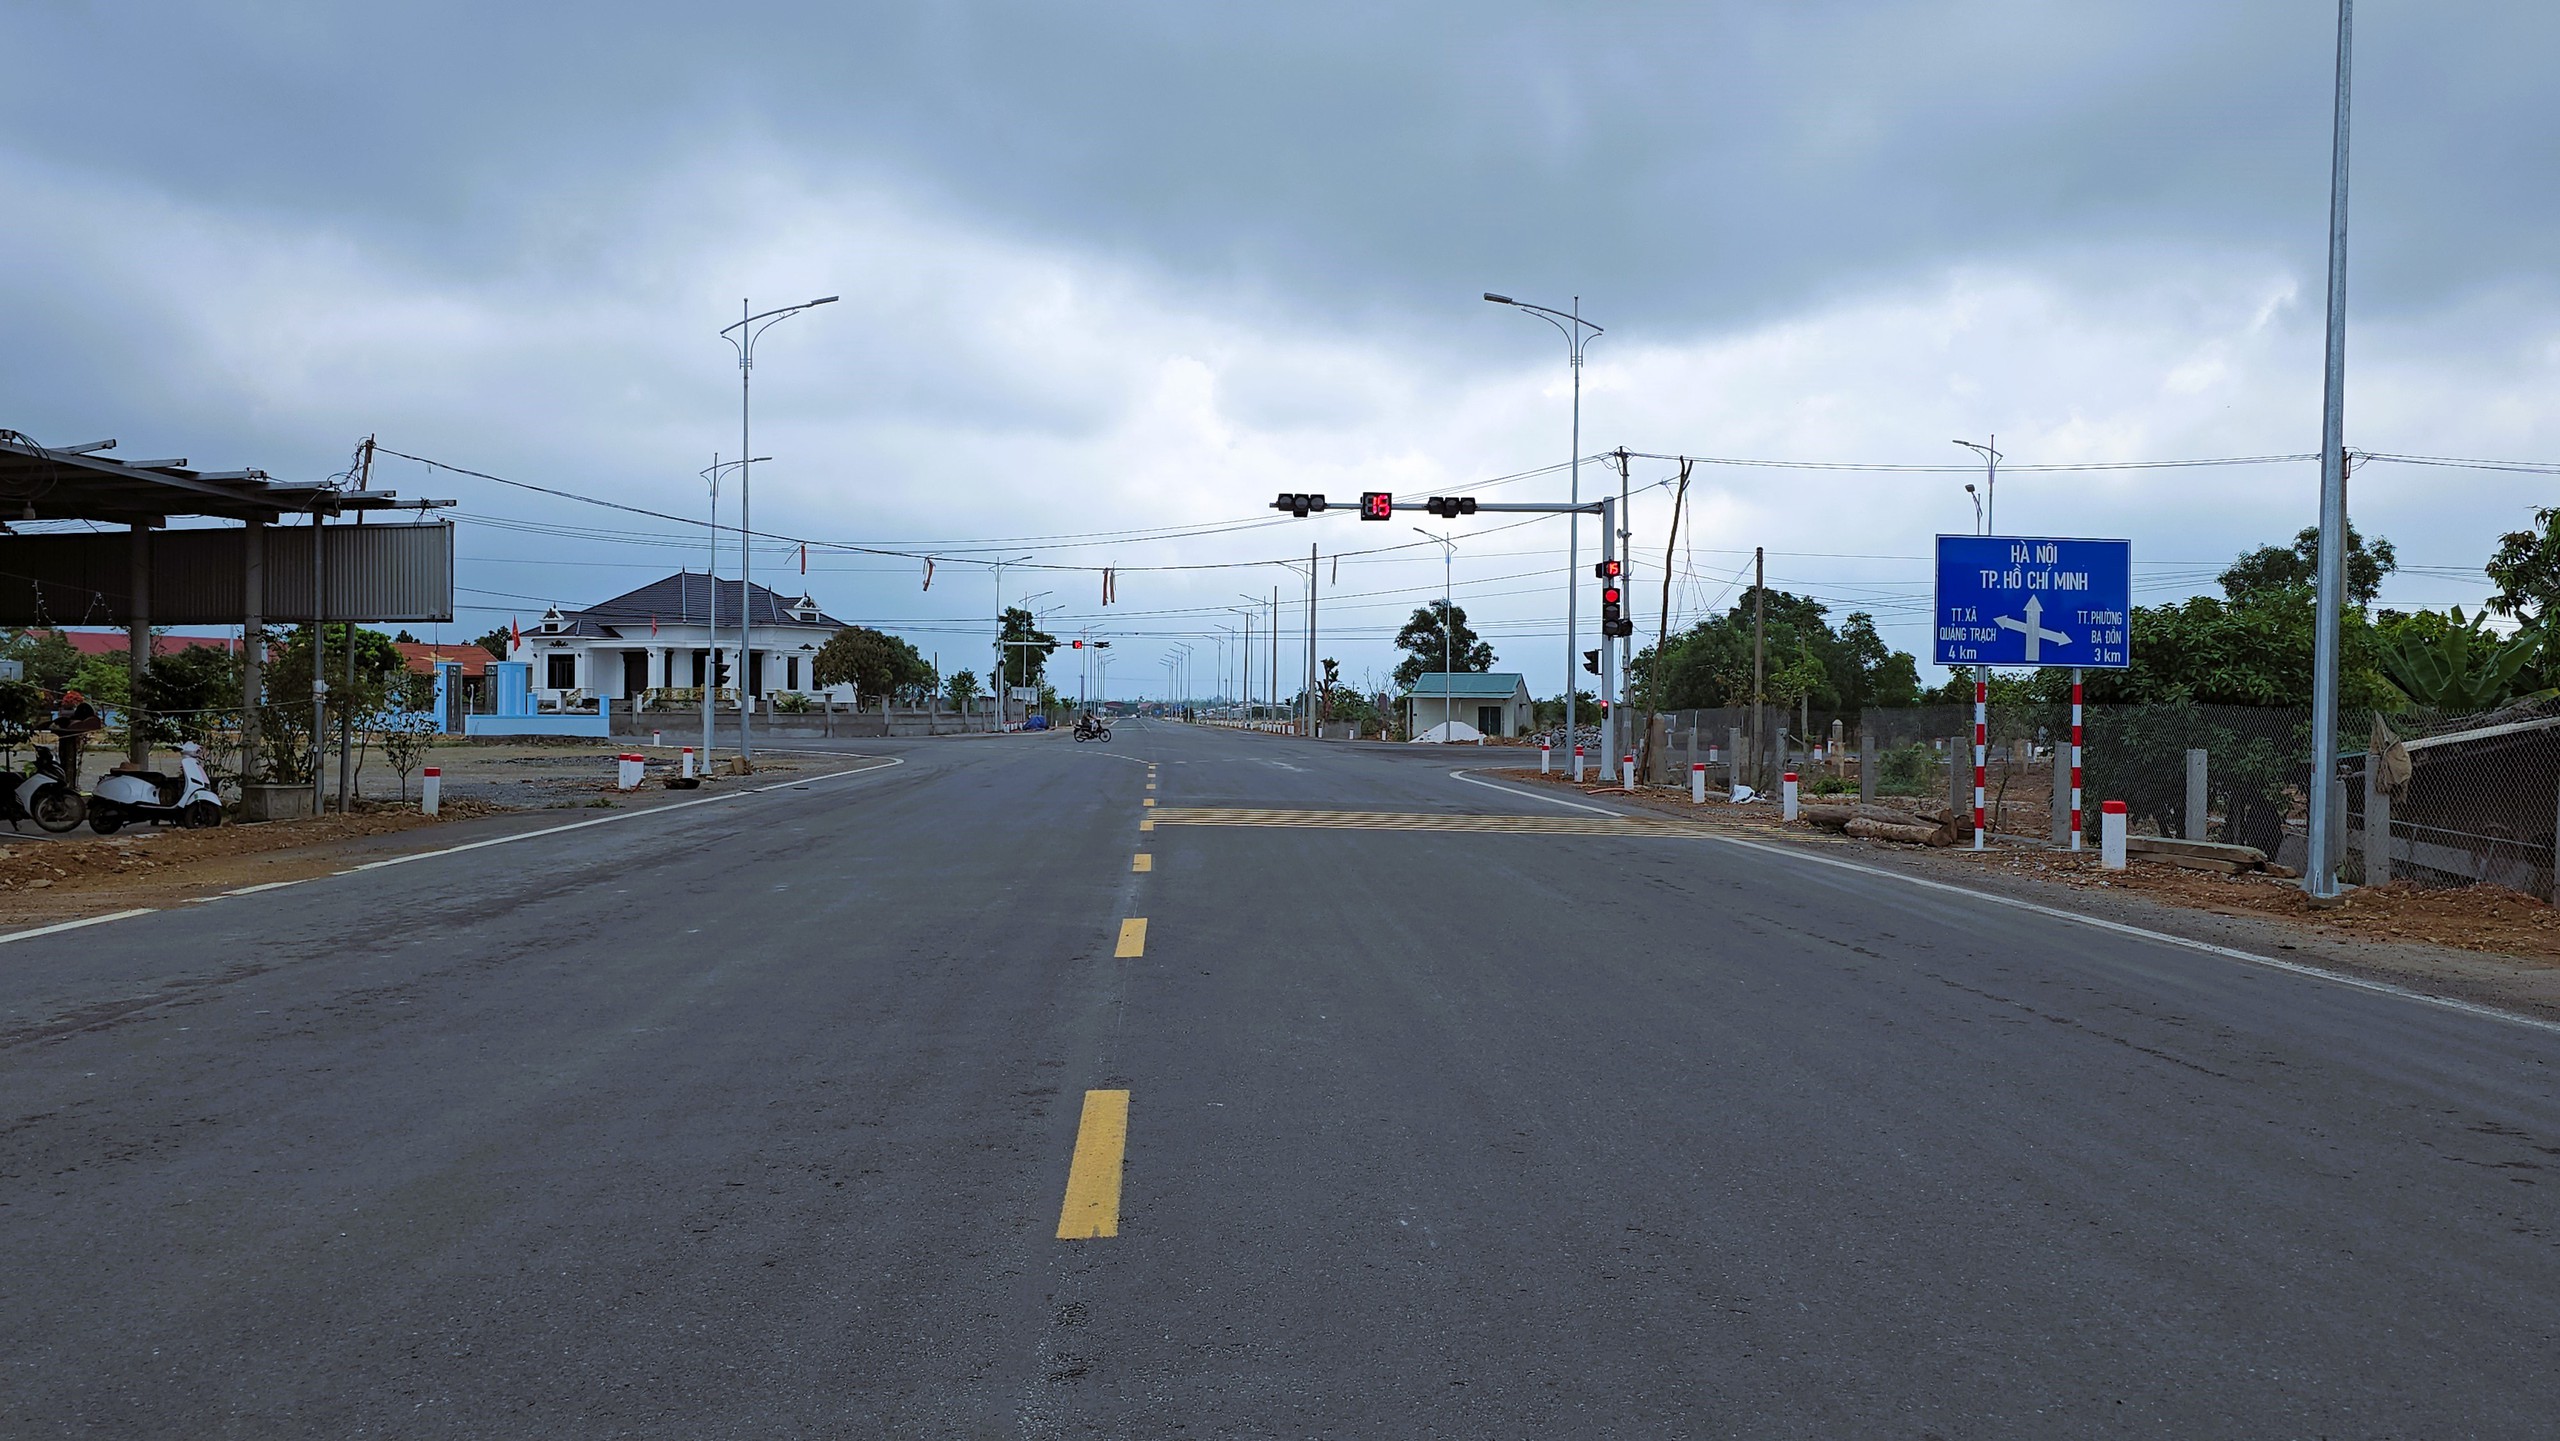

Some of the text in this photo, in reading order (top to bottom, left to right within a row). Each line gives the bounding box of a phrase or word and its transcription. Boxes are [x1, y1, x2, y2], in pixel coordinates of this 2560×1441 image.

[2011, 540, 2058, 567] HÀ NỘI
[2027, 566, 2049, 590] CHÍ
[2054, 571, 2088, 591] MINH
[1939, 622, 1997, 644] QUẢNG TRẠCH
[2091, 625, 2122, 645] BA ĐỒN
[1948, 644, 1977, 660] 4 km
[2094, 647, 2121, 663] 3 km
